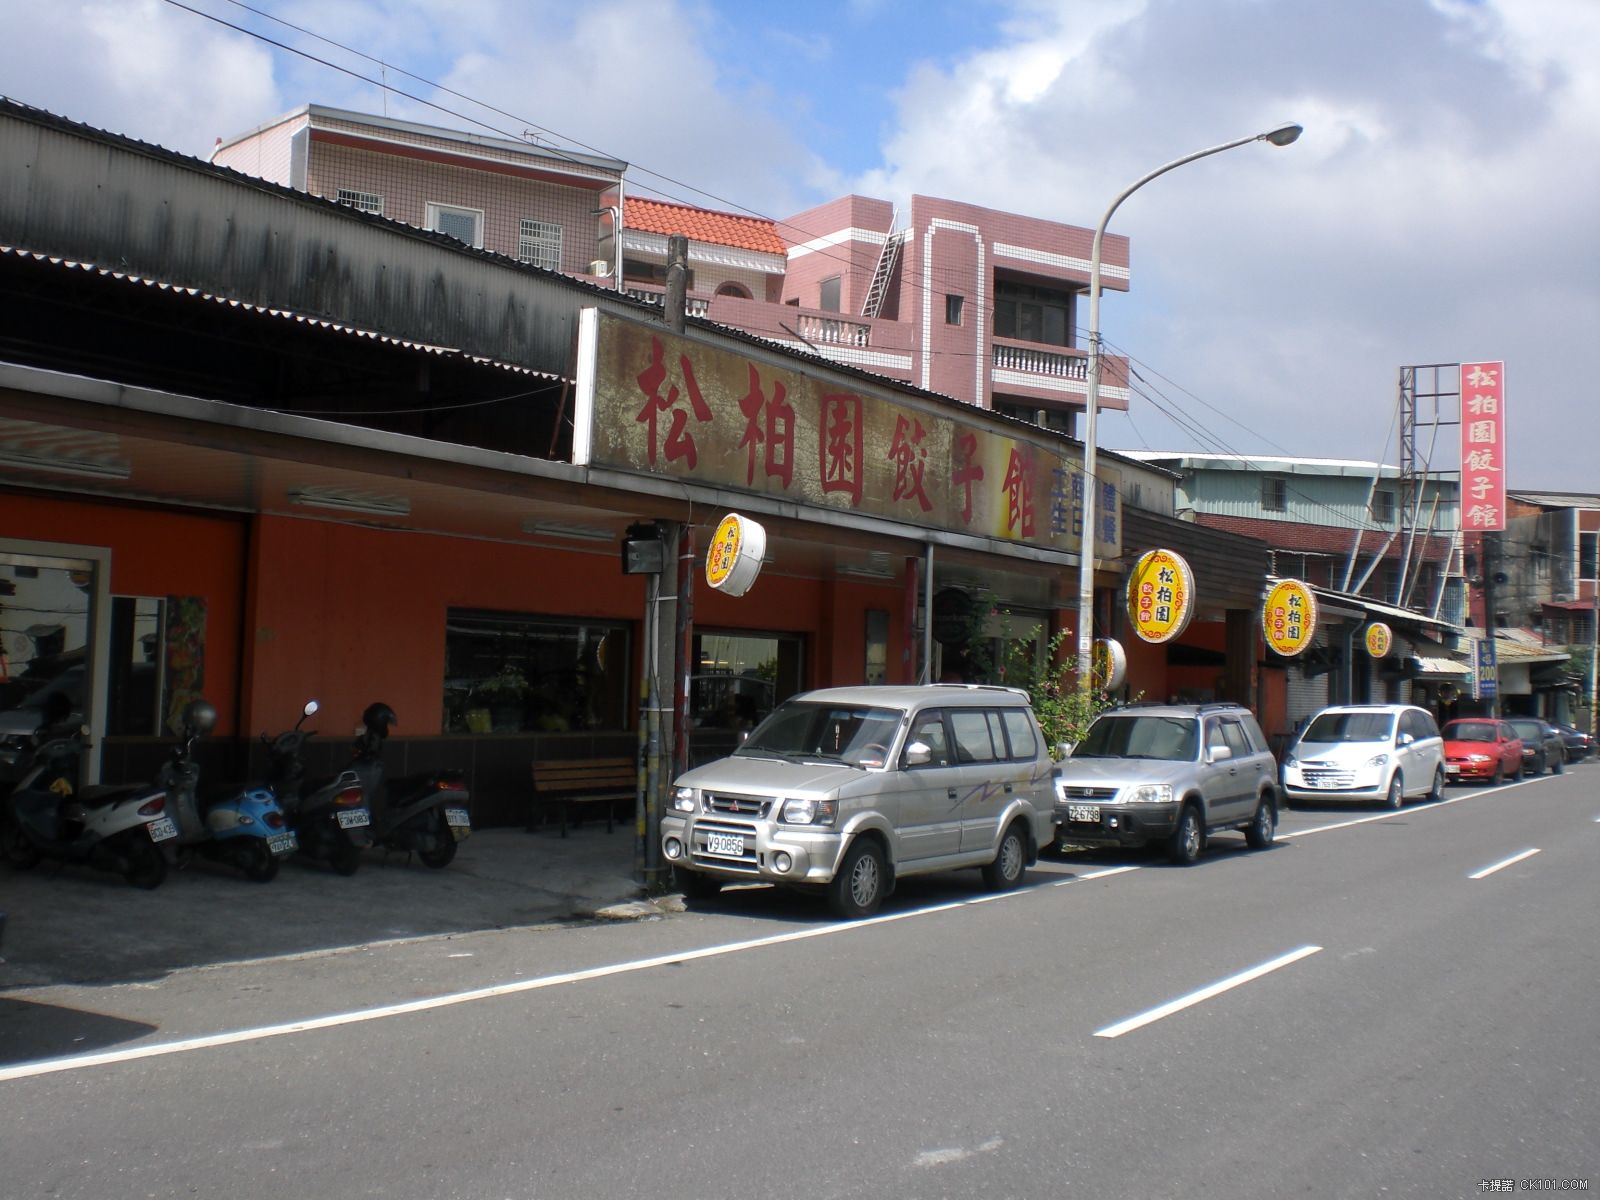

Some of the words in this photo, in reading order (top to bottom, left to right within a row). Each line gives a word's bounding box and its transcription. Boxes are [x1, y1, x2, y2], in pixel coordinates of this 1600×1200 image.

[635, 335, 1036, 539] 松柏園餃子館
[1464, 366, 1501, 528] 松柏園餃子館
[1155, 567, 1175, 623] 松柏園
[1287, 594, 1302, 640] 松柏園
[1480, 666, 1496, 681] 200
